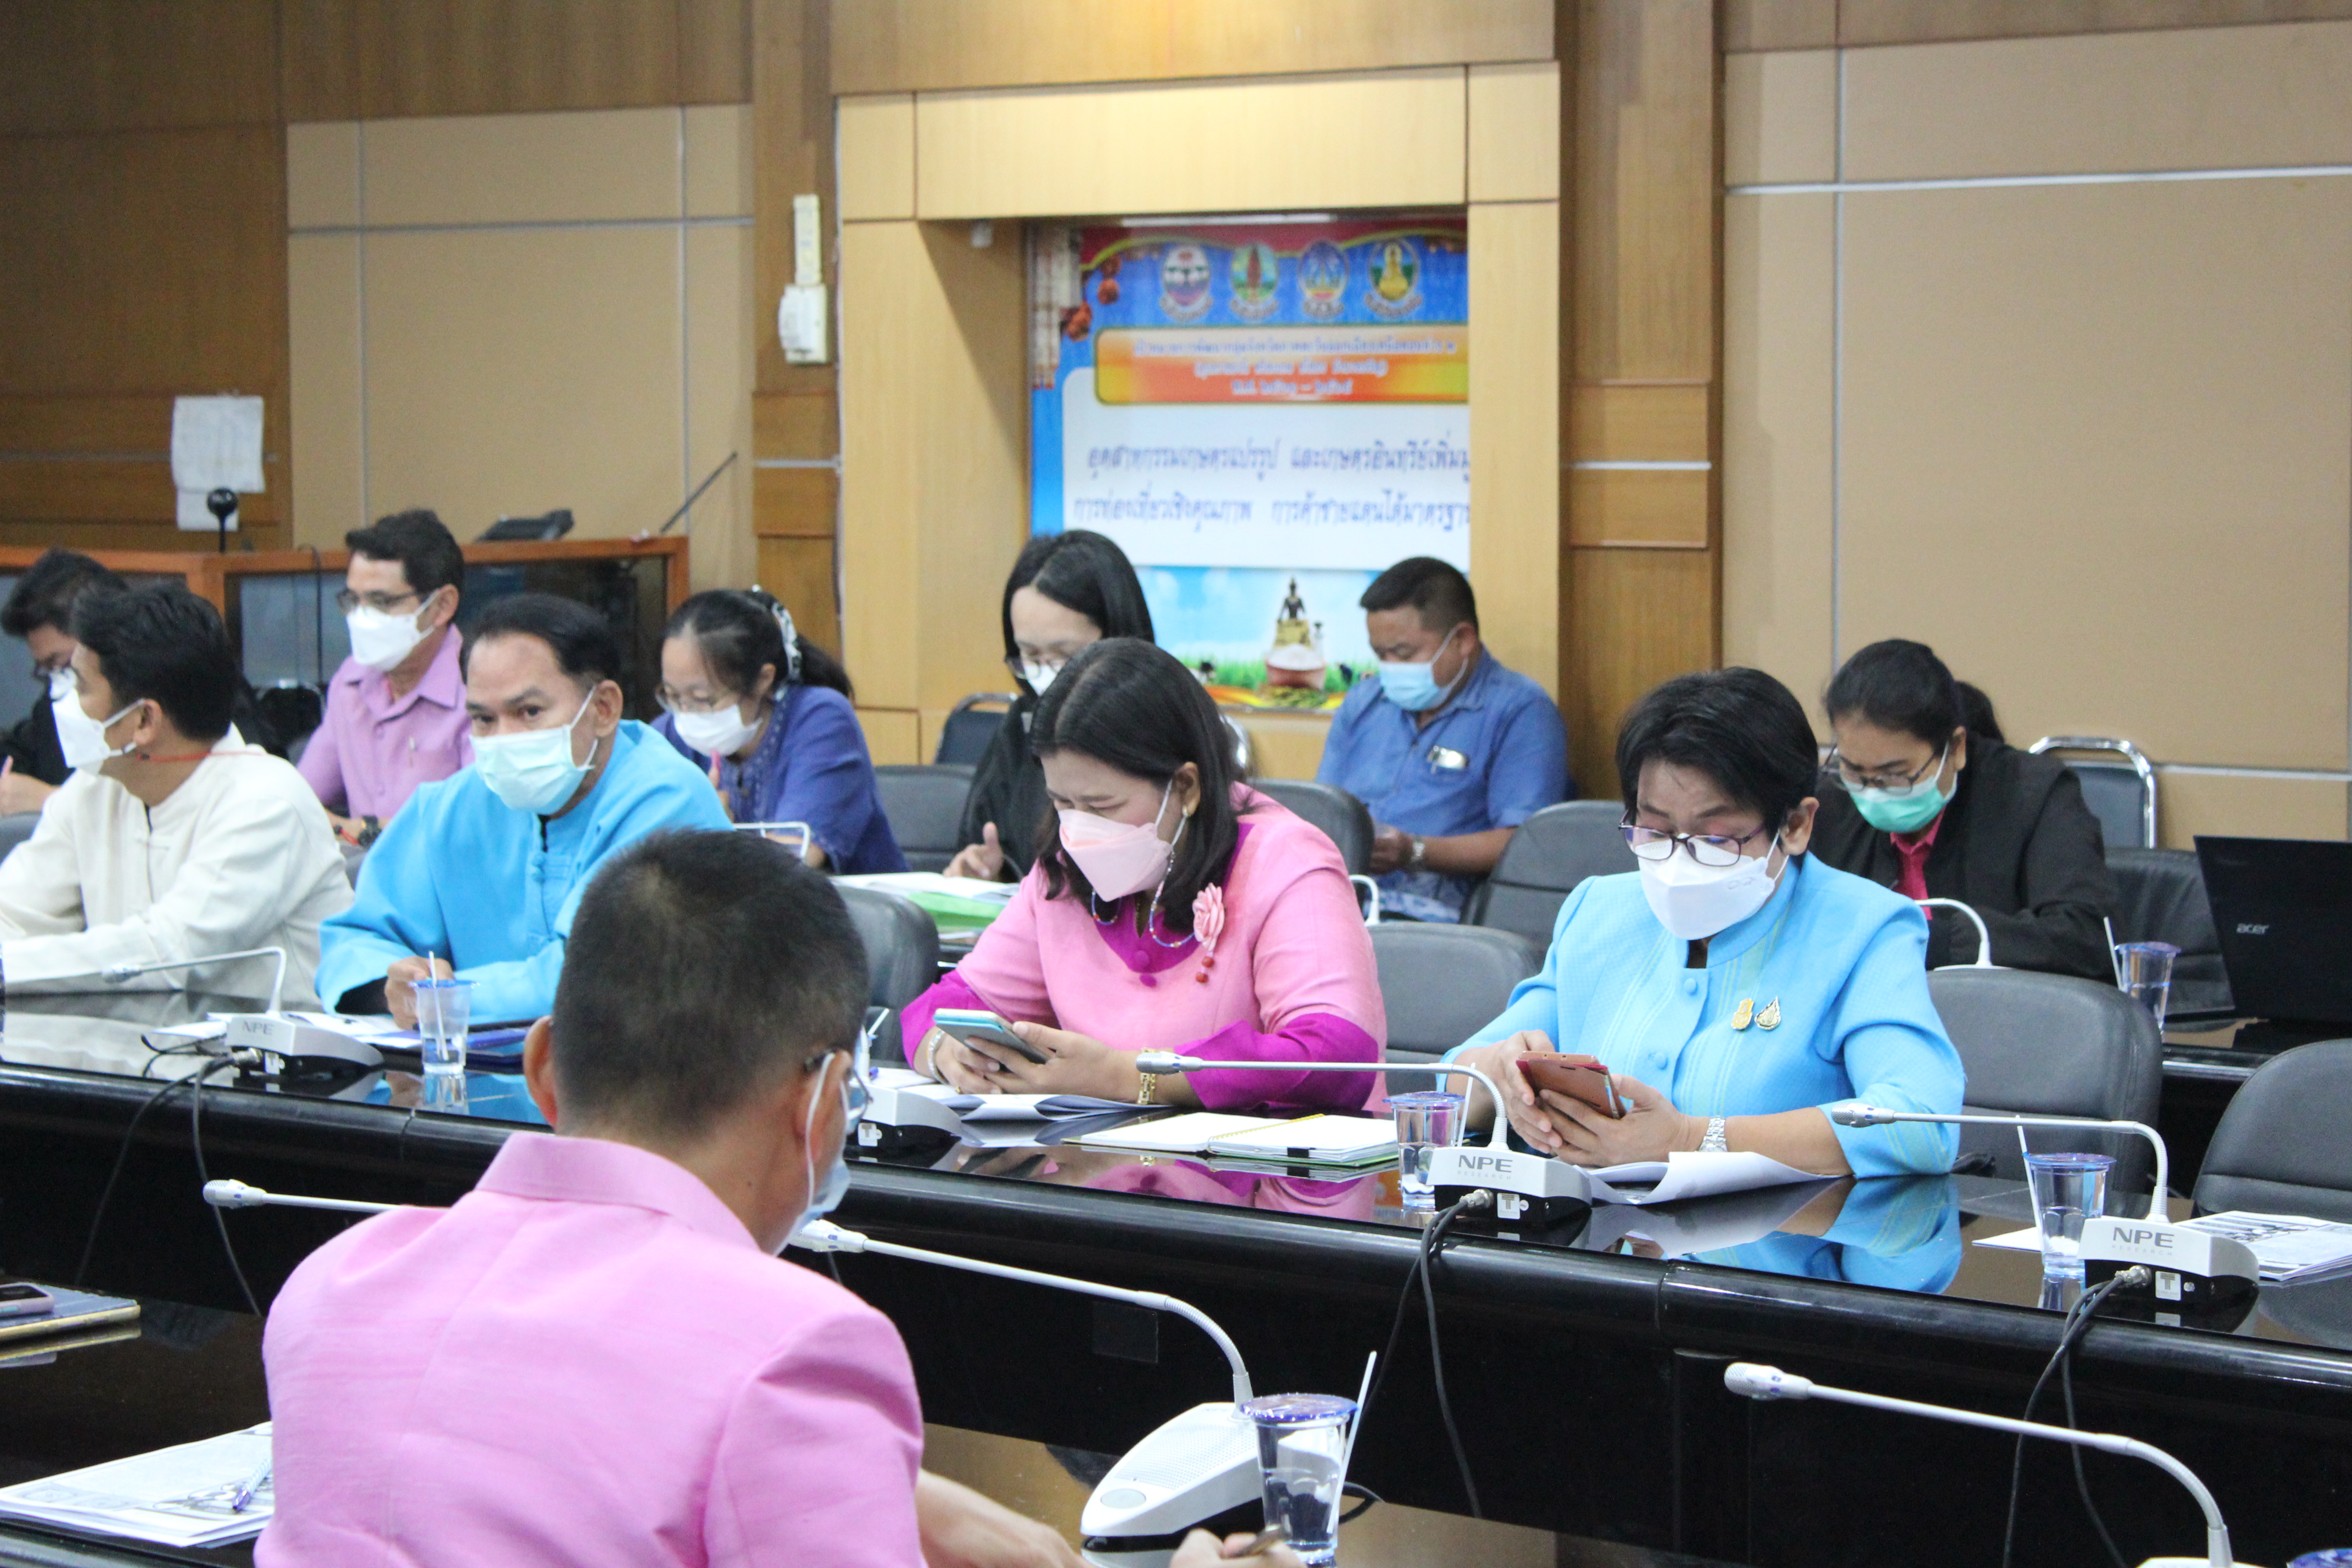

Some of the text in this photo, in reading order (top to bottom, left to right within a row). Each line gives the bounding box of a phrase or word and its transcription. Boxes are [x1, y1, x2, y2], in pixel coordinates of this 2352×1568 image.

[2236, 923, 2269, 935] acer
[1458, 1154, 1513, 1173] NPE
[1457, 1170, 1511, 1180] RESEARCH
[2113, 1226, 2175, 1249] NPE
[2112, 1244, 2172, 1256] RESEARCH
